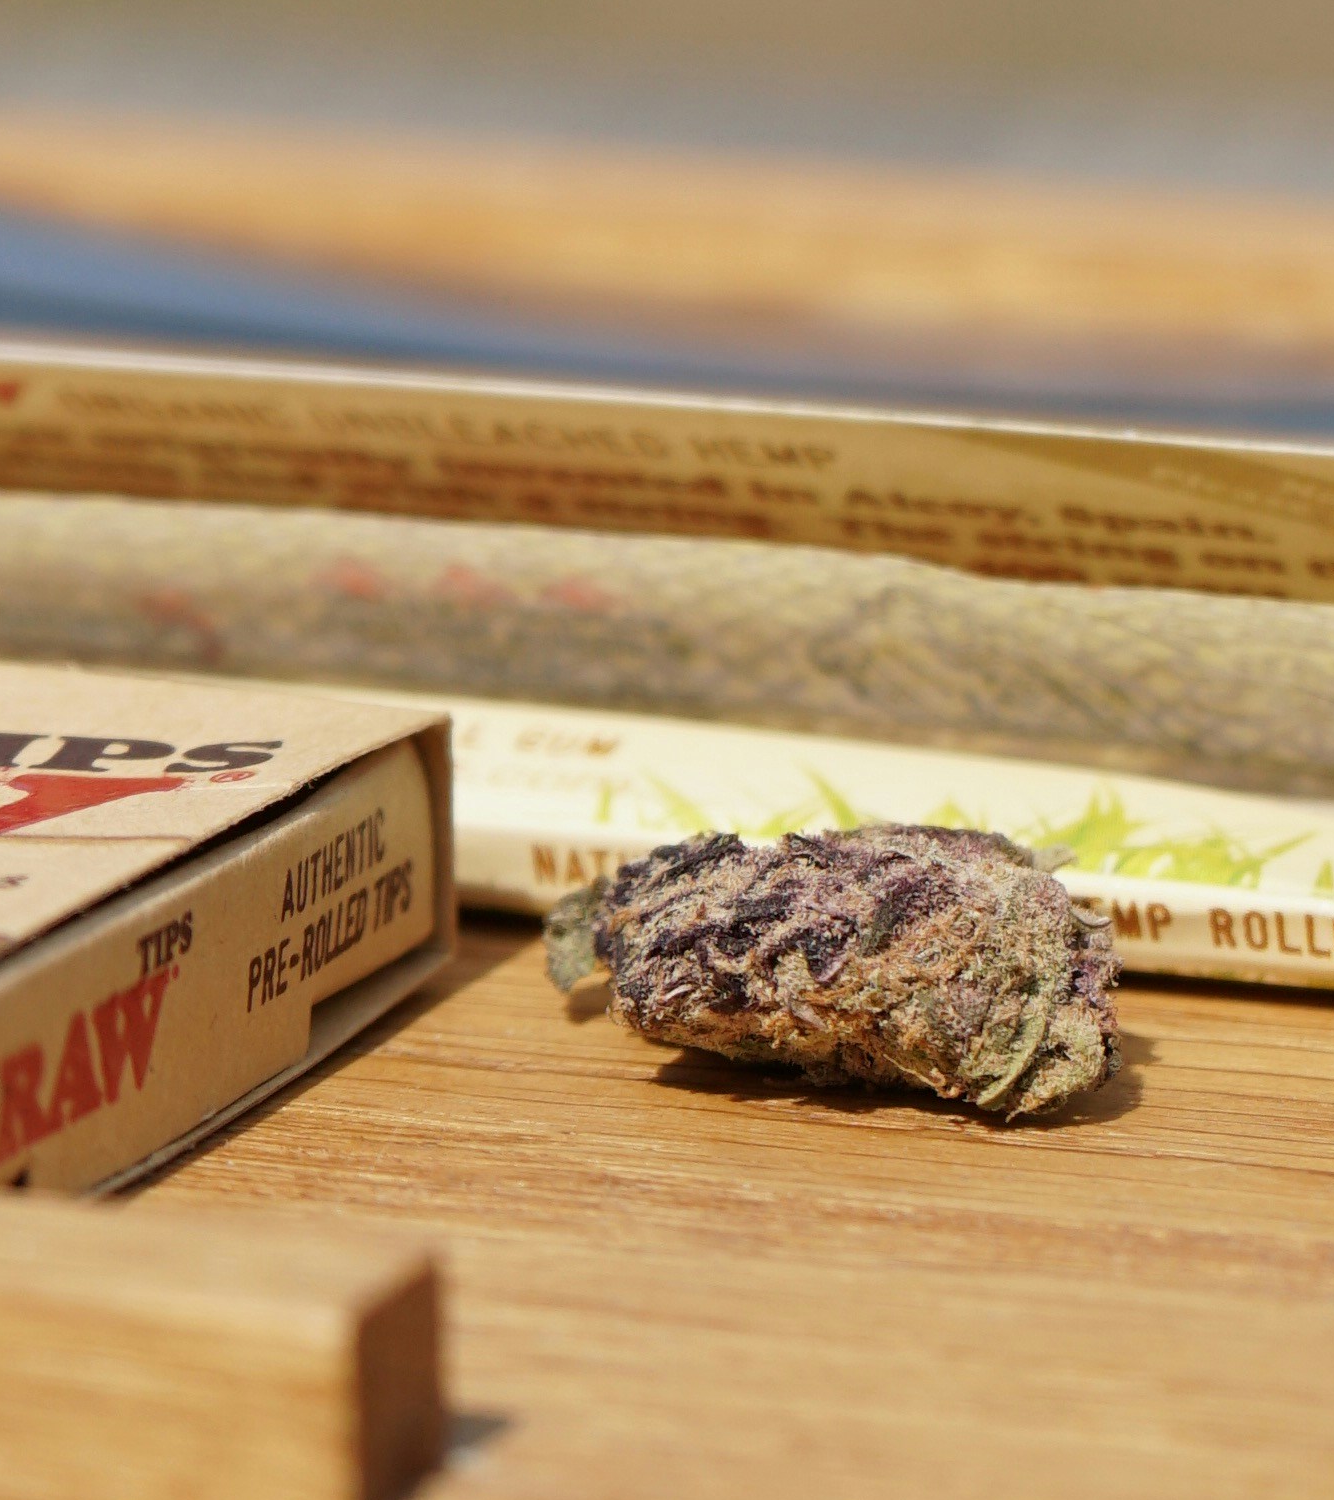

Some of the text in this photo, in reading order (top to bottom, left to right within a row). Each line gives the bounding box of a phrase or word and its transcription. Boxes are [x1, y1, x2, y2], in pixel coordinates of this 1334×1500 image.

[687, 433, 838, 470] HEMP
[280, 806, 386, 923] AUTHENTIC
[136, 908, 194, 978] TIPS
[246, 857, 413, 1014] PRE-ROLLED TIPS
